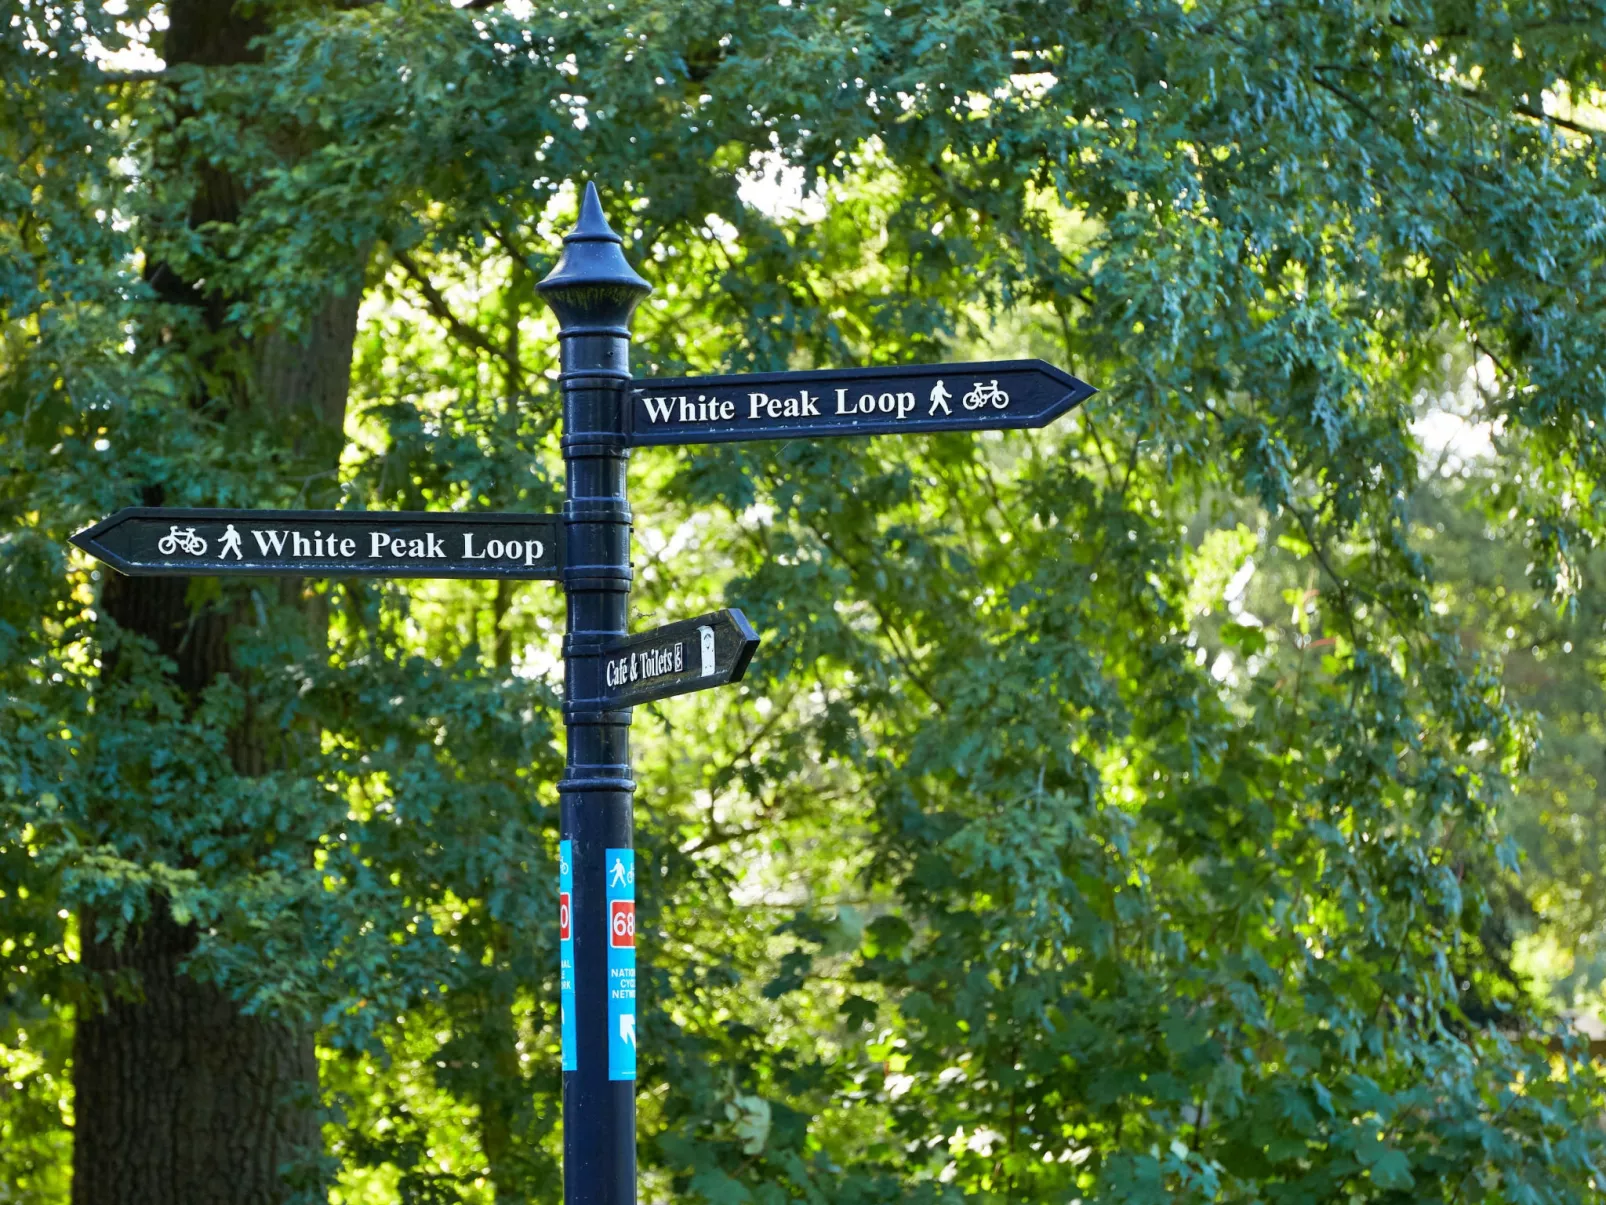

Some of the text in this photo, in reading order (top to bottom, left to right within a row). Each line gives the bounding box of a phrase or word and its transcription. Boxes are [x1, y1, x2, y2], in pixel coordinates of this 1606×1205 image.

[642, 388, 916, 423] White Peak Loop
[251, 530, 544, 566] White Peak Loop
[606, 648, 673, 687] Café & Toilets
